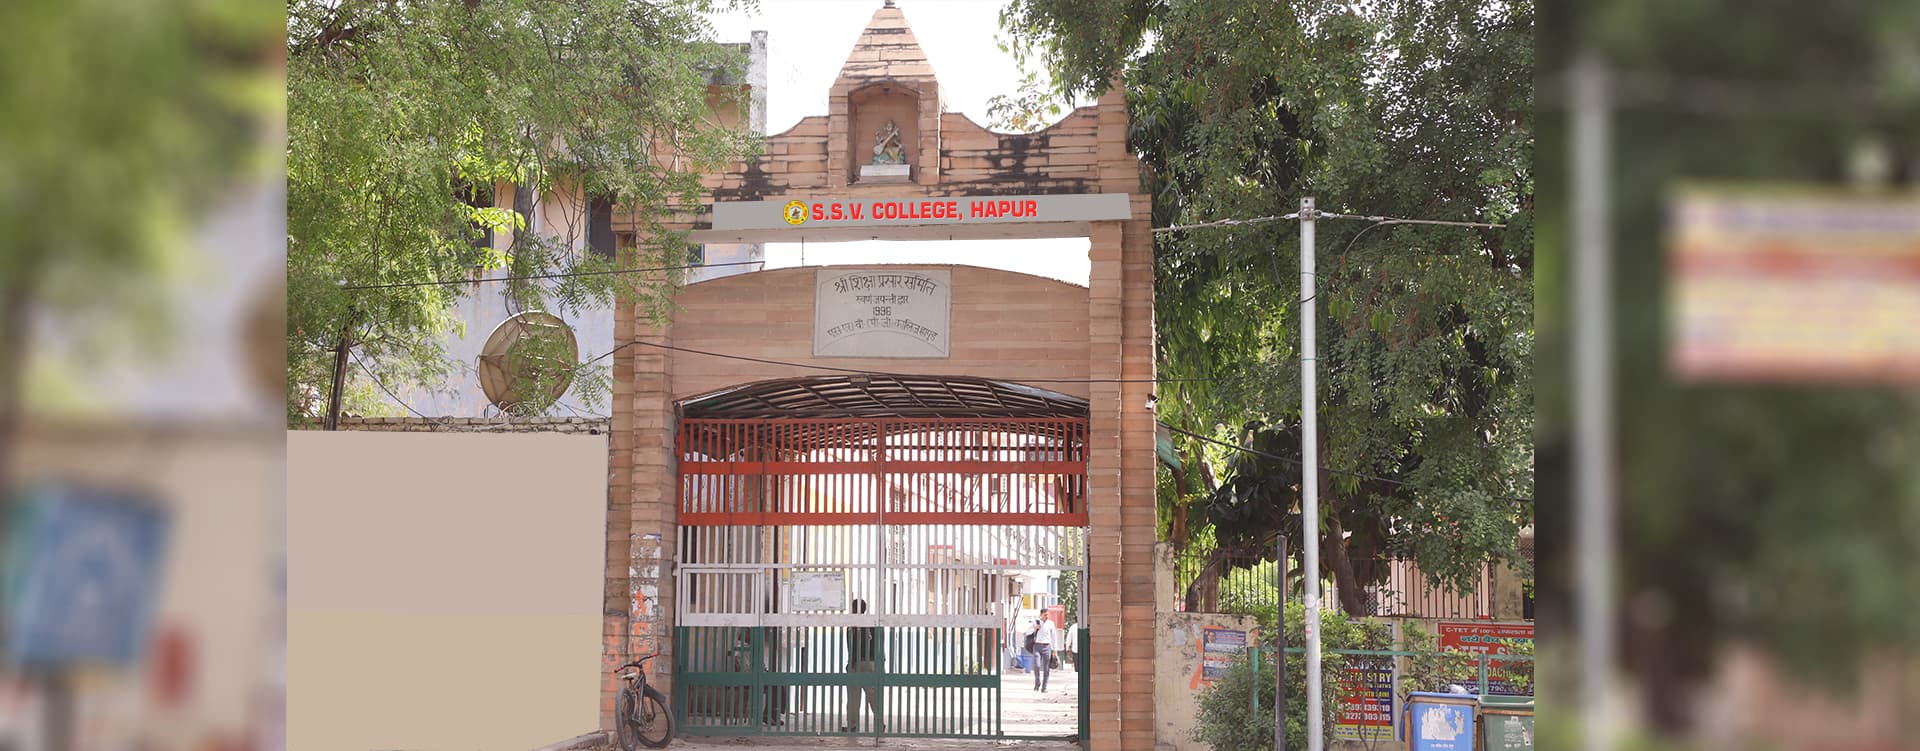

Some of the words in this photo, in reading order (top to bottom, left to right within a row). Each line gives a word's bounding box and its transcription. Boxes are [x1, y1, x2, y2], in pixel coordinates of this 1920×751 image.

[812, 203, 865, 220] S.S.V.
[872, 201, 963, 221] COLLEGE,
[971, 200, 1037, 218] HAPUR
[872, 306, 891, 316] 1996
